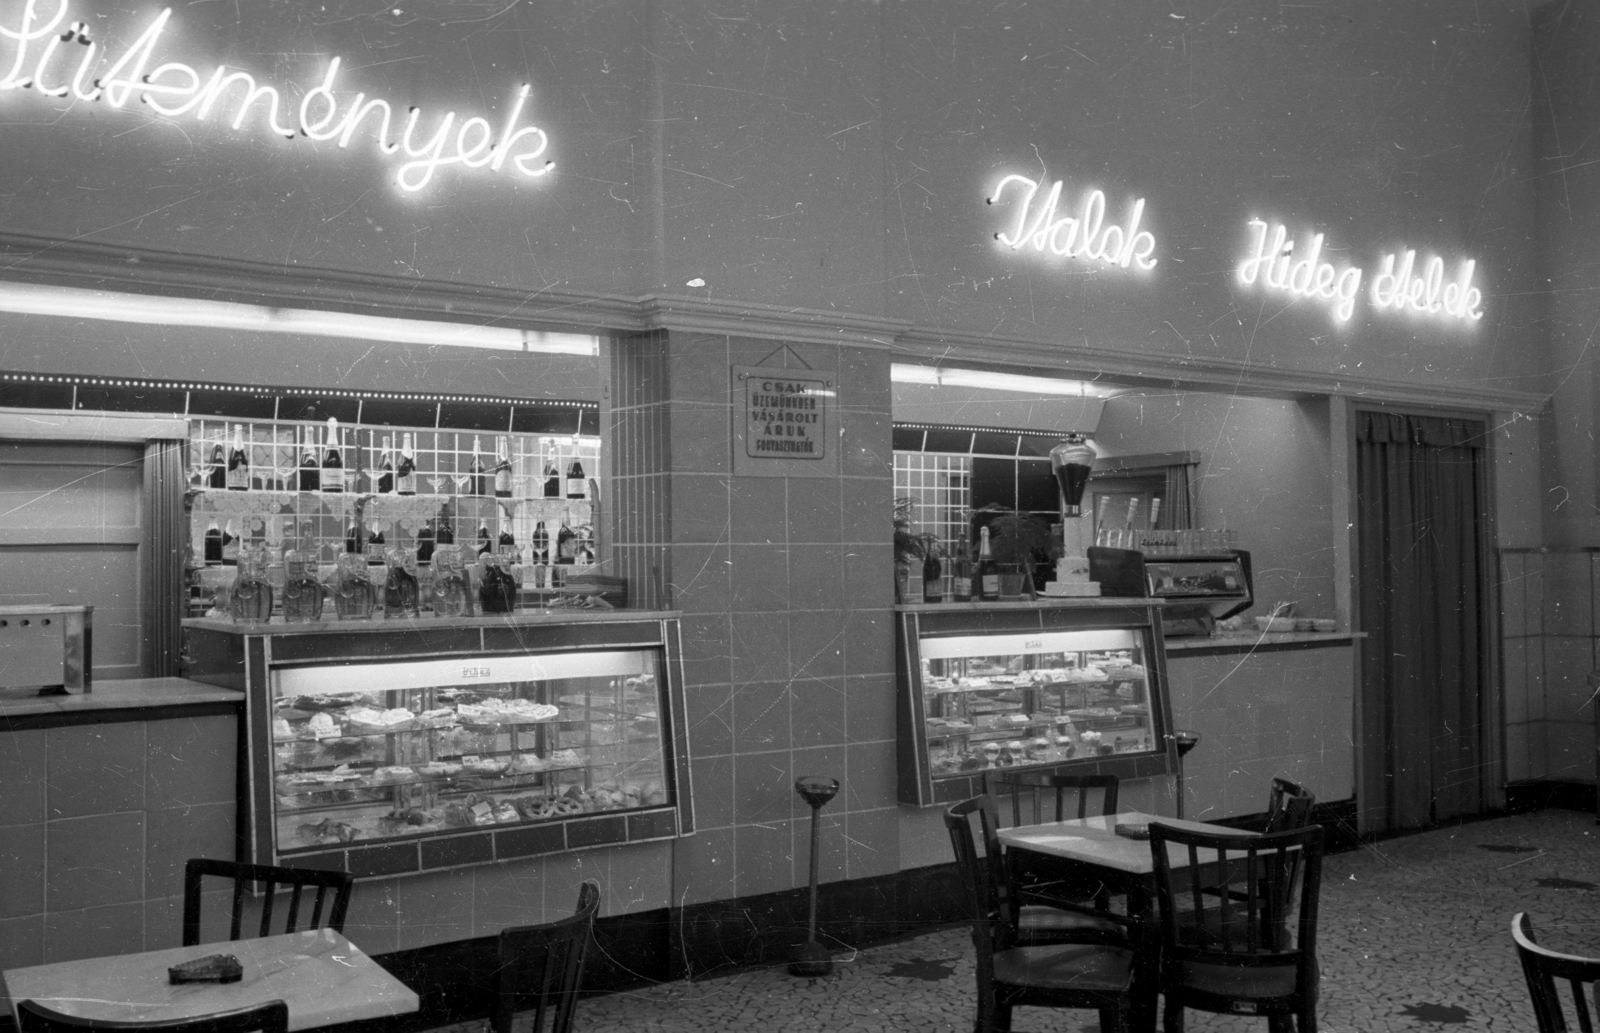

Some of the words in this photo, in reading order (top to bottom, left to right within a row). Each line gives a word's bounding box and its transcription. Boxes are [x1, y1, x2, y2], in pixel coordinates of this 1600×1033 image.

[988, 174, 1158, 270] Italok
[1240, 219, 1362, 322] Hideg
[1374, 248, 1484, 319] ételek
[762, 381, 807, 394] CSAK
[751, 408, 819, 424] VÁSÁROLT
[763, 421, 806, 437] ÁRUK
